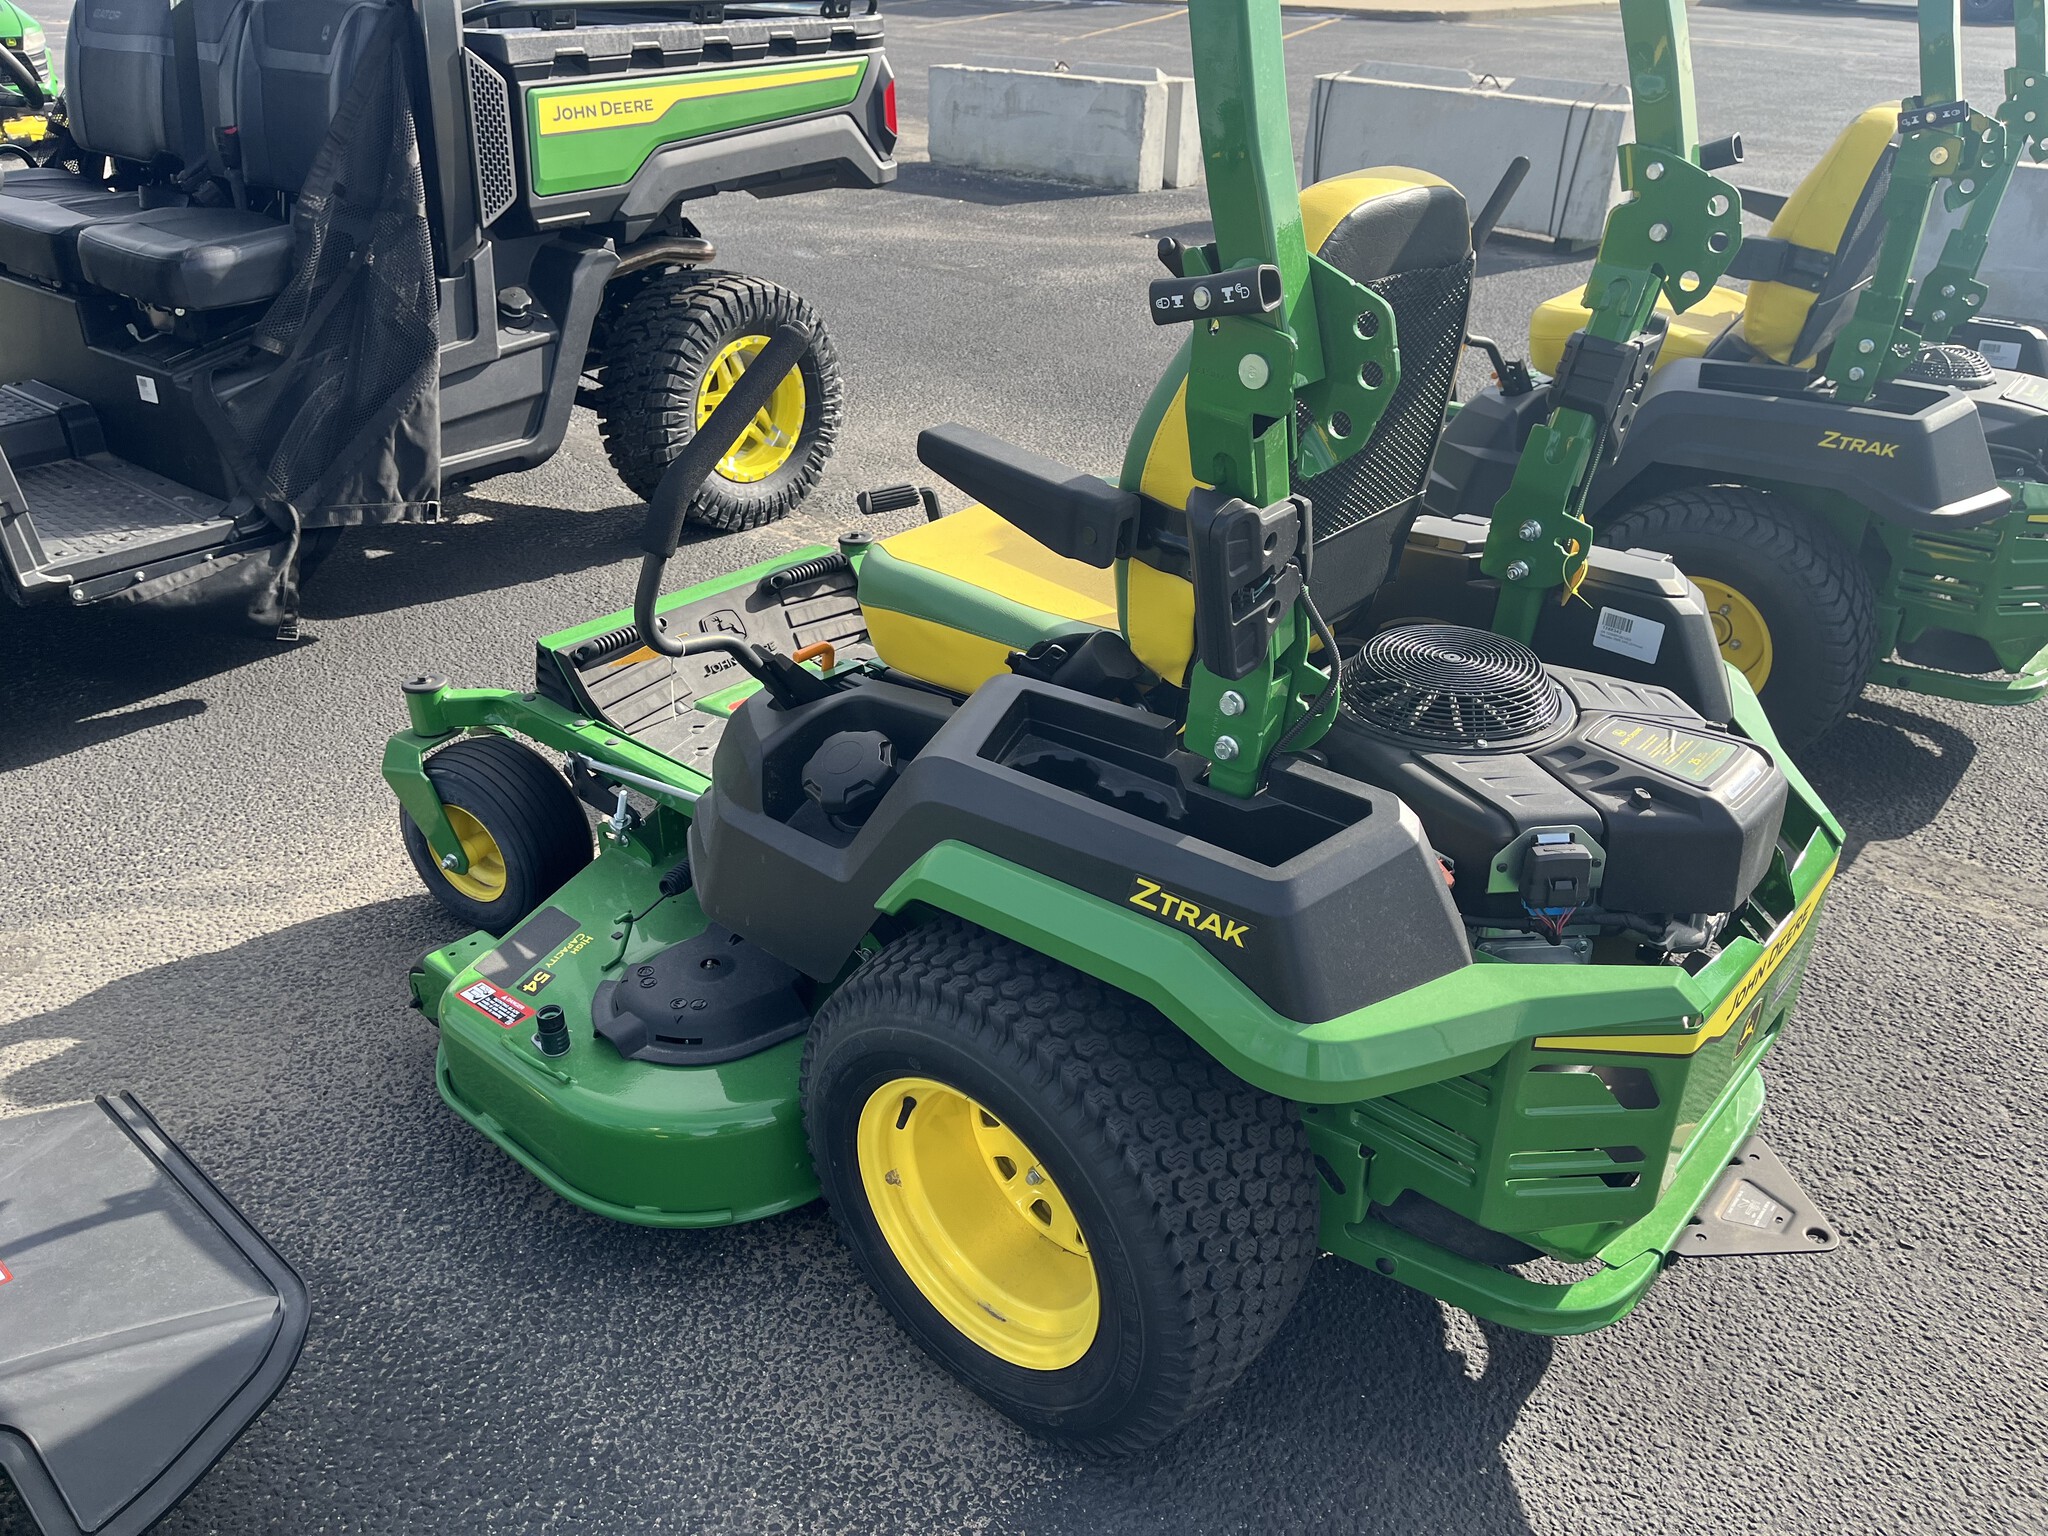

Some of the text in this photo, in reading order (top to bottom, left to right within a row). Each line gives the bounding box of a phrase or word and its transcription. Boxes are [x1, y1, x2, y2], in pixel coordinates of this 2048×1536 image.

[552, 98, 654, 122] JOHN DEERE
[1818, 430, 1900, 458] ZTRAK
[1129, 877, 1250, 948] ZTRAK
[545, 932, 586, 969] CAPACITY
[570, 935, 594, 955] HIGH
[1726, 962, 1768, 1021] JOHN
[1766, 903, 1812, 969] DEERE
[522, 971, 552, 992] 54
